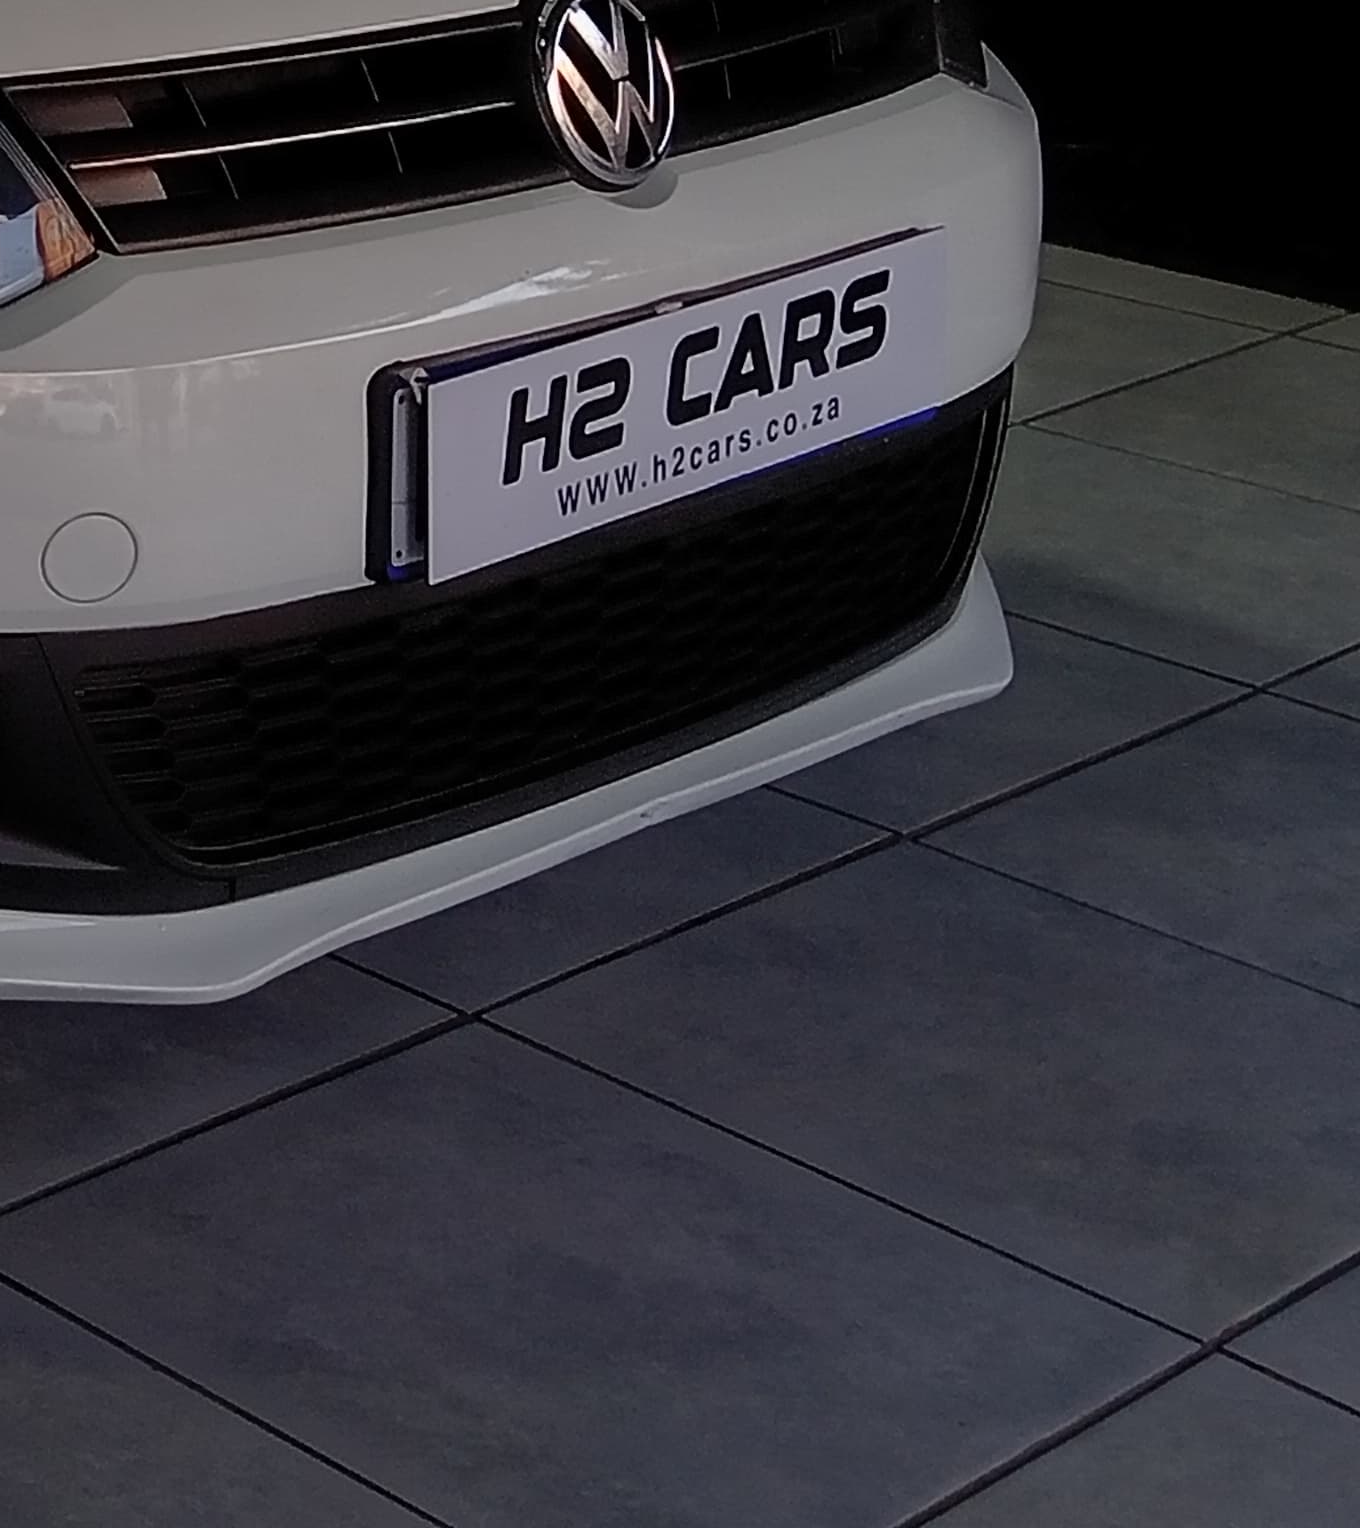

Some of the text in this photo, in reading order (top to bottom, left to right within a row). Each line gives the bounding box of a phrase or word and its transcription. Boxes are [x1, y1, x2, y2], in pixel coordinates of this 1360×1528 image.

[502, 269, 890, 485] H2 CARS
[557, 395, 840, 517] www.h2cars.co.za
